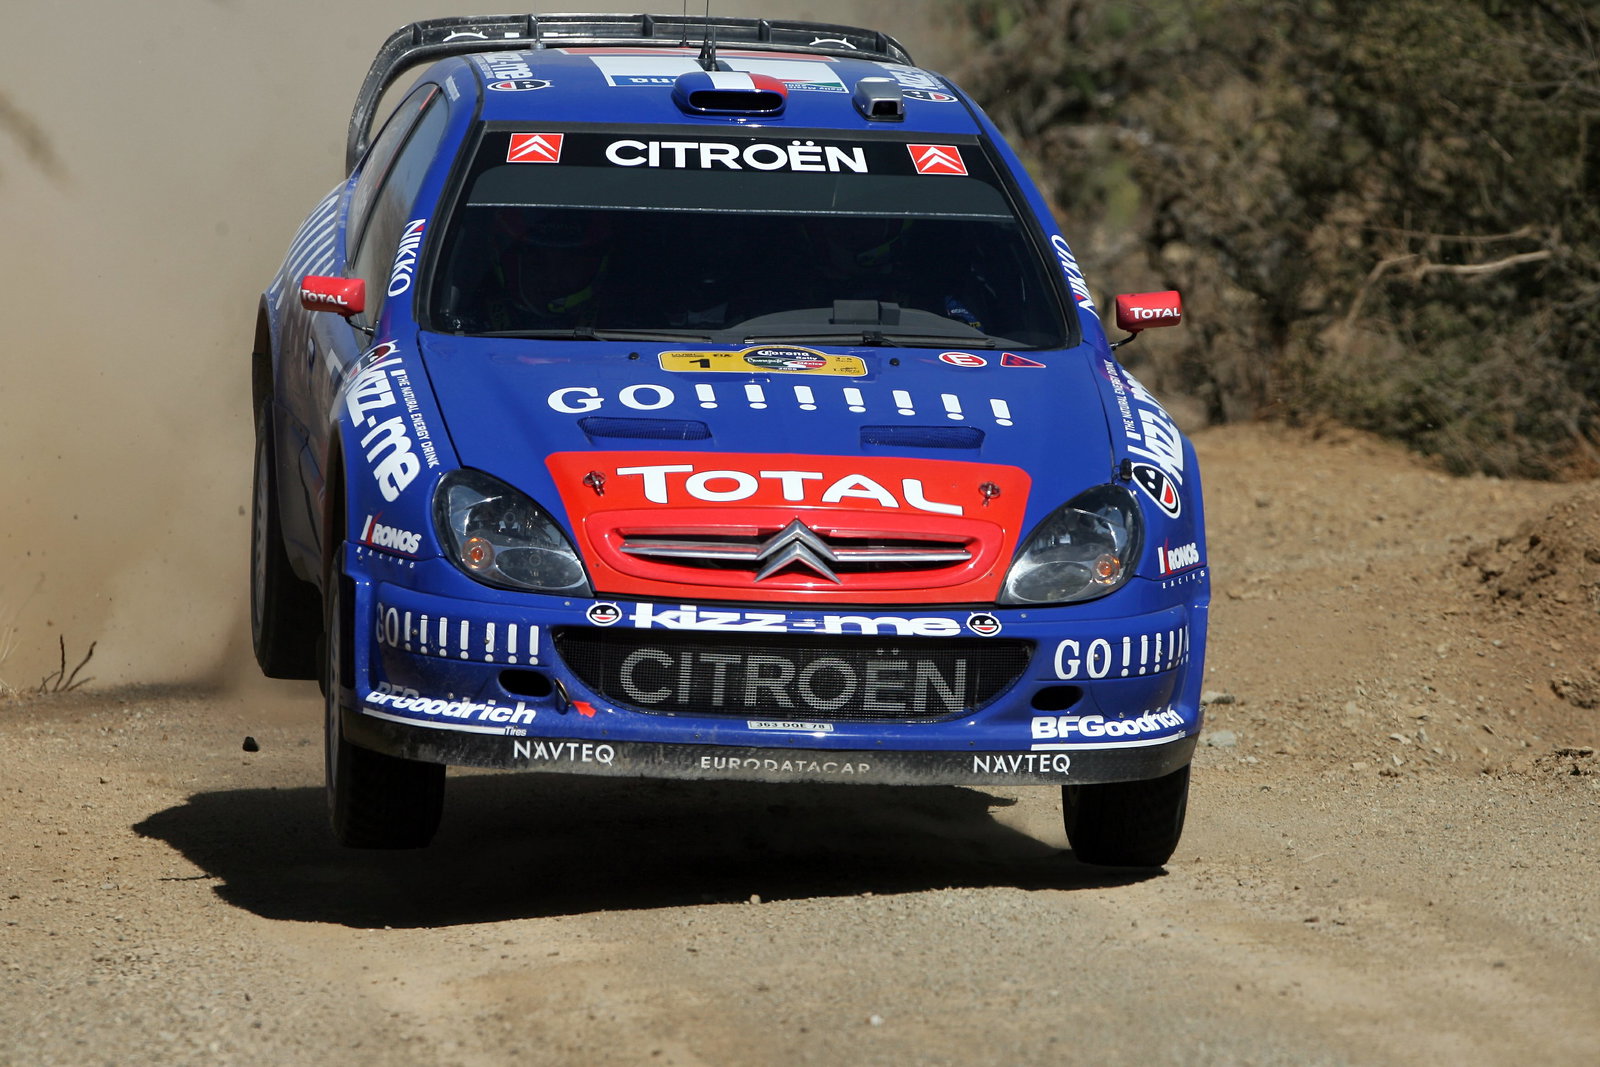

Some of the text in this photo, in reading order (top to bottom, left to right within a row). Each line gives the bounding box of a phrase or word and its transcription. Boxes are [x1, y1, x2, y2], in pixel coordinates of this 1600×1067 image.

[605, 139, 868, 173] CITROËN
[387, 218, 426, 297] NIKKO
[301, 289, 348, 305] TOTAL
[1130, 307, 1181, 320] TOTAL
[689, 358, 711, 369] 1
[396, 374, 440, 469] THE NATURAL ENERGY DRINK
[615, 464, 964, 516] TOTAL
[1162, 570, 1205, 589] RACING
[620, 648, 967, 712] CITROËN
[365, 681, 537, 724] BFGoodrich
[503, 725, 527, 736] Tires
[1031, 703, 1185, 739] BFGoodrich
[513, 740, 615, 767] NAVTEQ
[700, 756, 870, 774] EURODATACAR
[973, 753, 1071, 776] NAVTEQ
